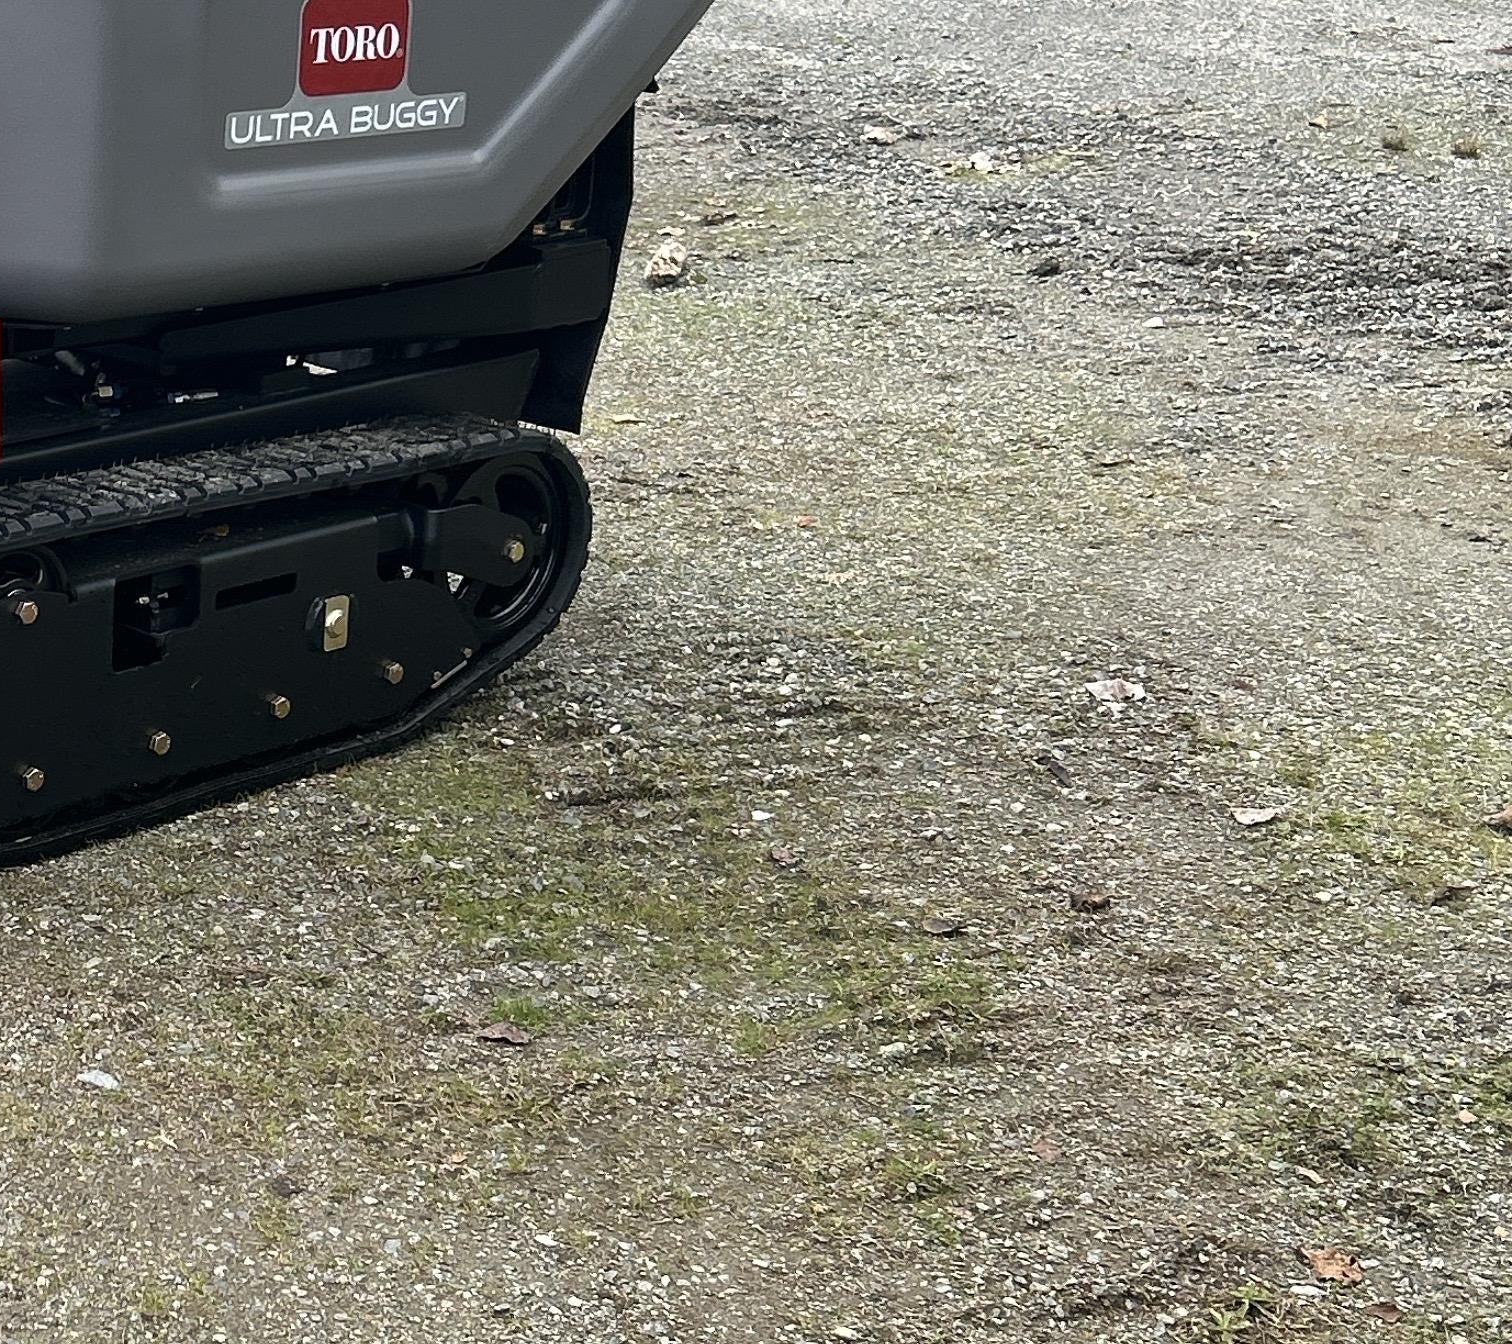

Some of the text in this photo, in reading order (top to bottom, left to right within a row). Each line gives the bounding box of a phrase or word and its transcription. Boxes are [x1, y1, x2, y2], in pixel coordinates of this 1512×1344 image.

[310, 23, 399, 64] TORO
[231, 98, 459, 144] ULTRA BUGGY
